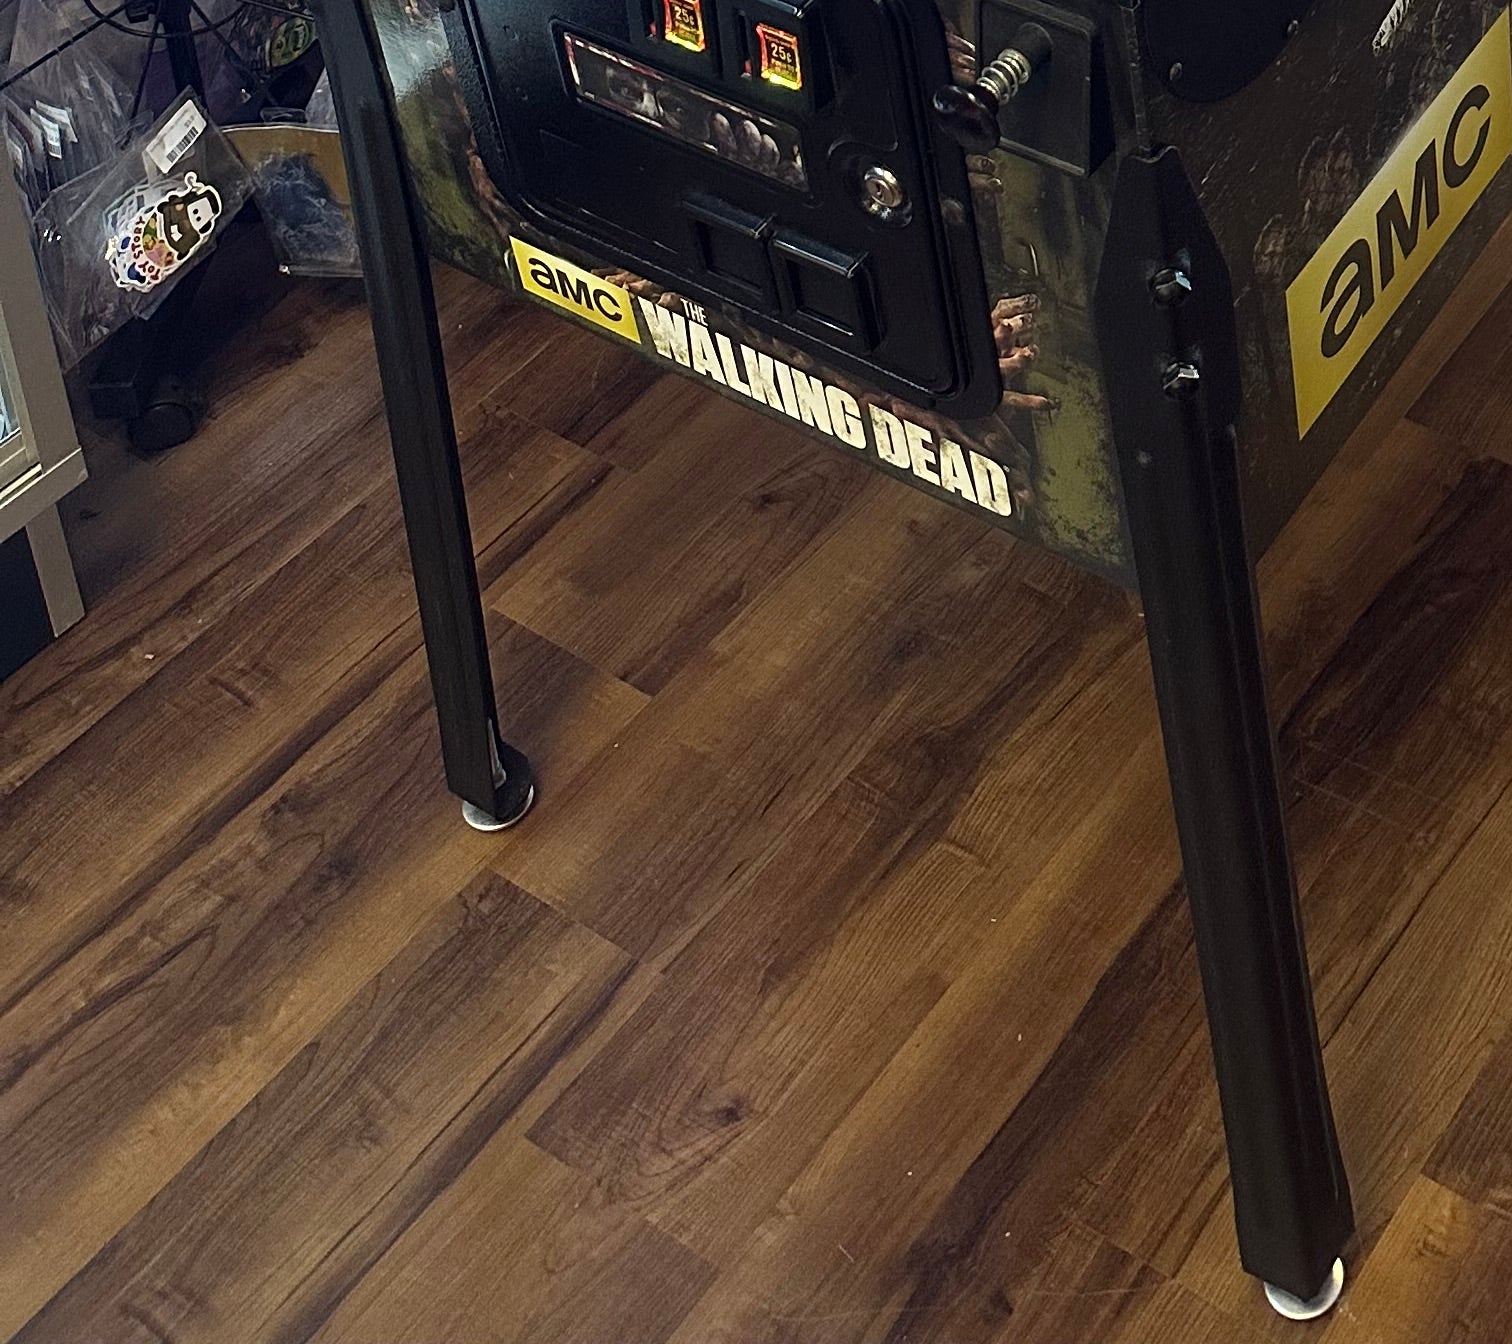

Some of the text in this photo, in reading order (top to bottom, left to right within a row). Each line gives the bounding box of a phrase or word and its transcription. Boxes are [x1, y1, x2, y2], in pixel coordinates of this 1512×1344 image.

[674, 5, 695, 26] 25¢
[770, 43, 792, 63] 25¢
[131, 215, 161, 281] TOY STORY
[681, 296, 708, 326] THE
[638, 295, 867, 453] WALKING
[867, 404, 1014, 519] DEAD
